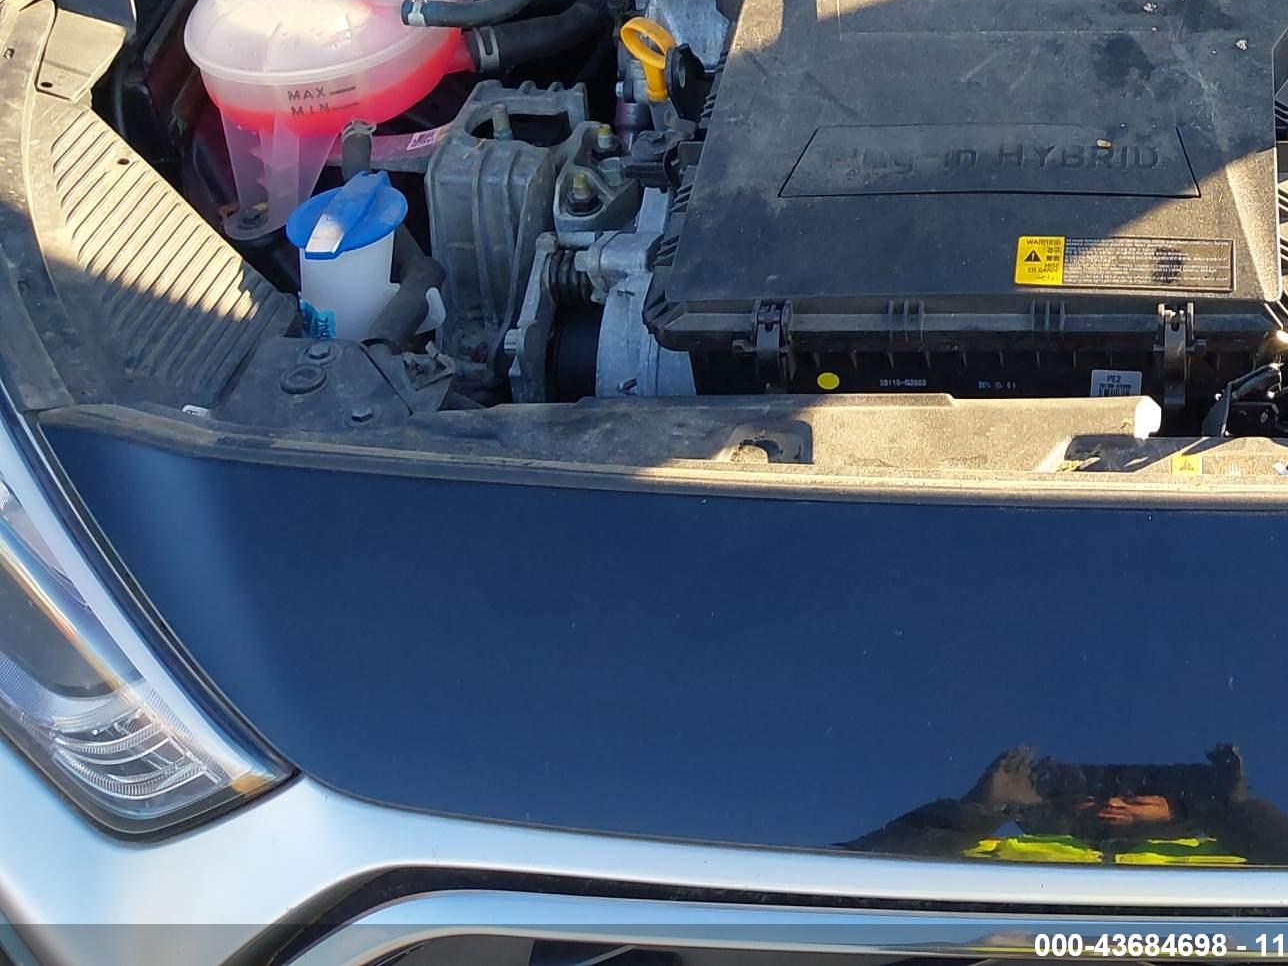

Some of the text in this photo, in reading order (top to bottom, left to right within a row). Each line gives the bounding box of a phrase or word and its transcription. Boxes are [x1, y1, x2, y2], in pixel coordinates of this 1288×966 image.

[287, 86, 326, 101] MAX
[290, 102, 330, 117] MIN
[999, 144, 1160, 171] HYBRID
